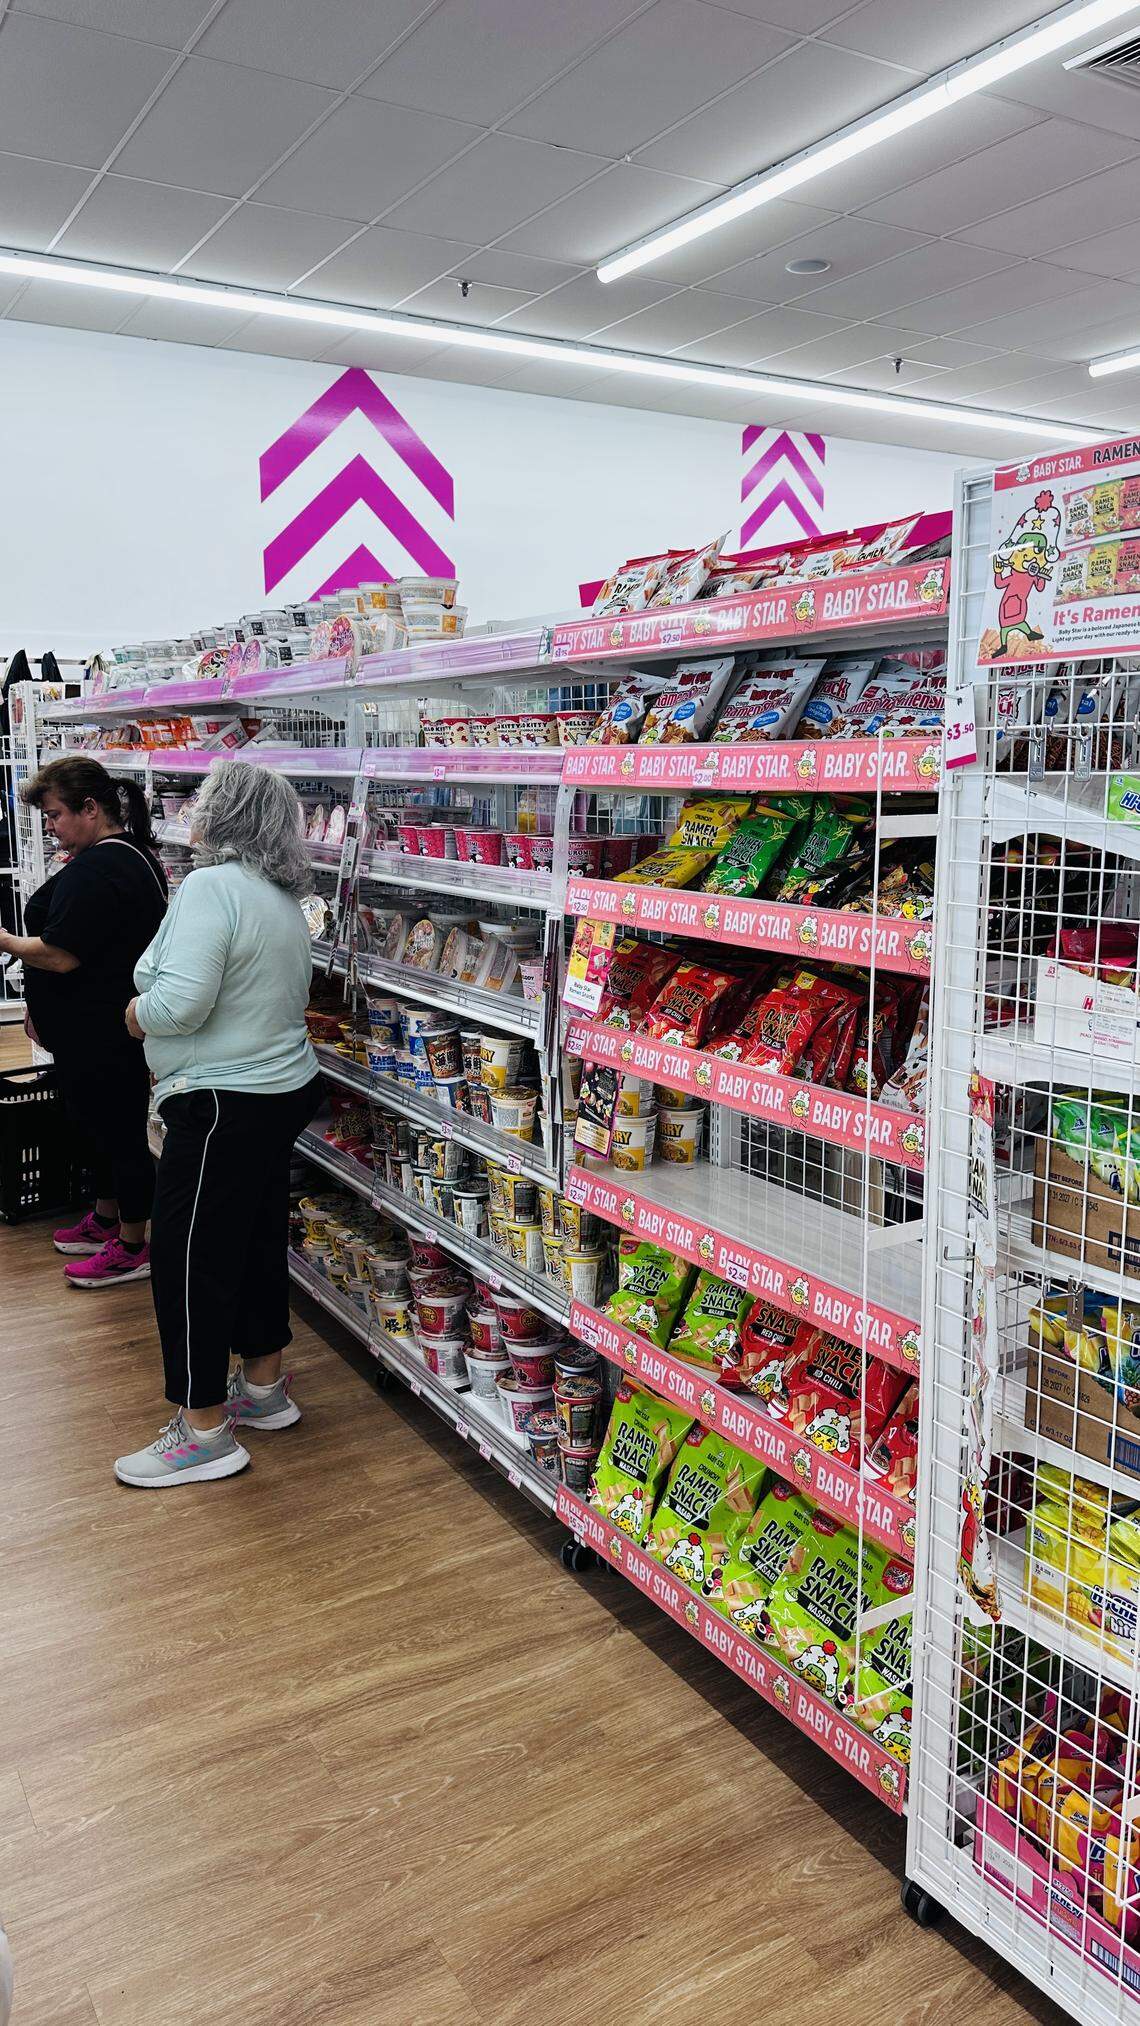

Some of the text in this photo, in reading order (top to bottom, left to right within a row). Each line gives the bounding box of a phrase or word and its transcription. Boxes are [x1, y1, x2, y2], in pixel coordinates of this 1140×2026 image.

[1033, 456, 1082, 478] BABY STAR
[752, 598, 788, 626] STAR
[823, 579, 910, 617] BABY STAR
[1053, 609, 1079, 626] It's
[580, 627, 605, 650] STAR
[946, 722, 975, 741] $3.50
[566, 755, 616, 775] BABY STAR
[639, 756, 696, 777] BABY STAR
[721, 755, 790, 778] BABY STAR
[823, 752, 866, 778] BABY
[680, 832, 715, 848] SNACK
[683, 820, 719, 838] RAMEN
[592, 891, 617, 913] STAR
[640, 898, 699, 926] BABY STAR
[724, 910, 791, 941] BABY STAR
[820, 922, 859, 949] BABY
[592, 1032, 616, 1057] STAR
[635, 1045, 690, 1079] BABY STAR
[717, 1072, 786, 1112] BABY STAR
[812, 1100, 853, 1133] BABY
[593, 1187, 617, 1214] STAR
[638, 1208, 693, 1251] BABY STAR
[728, 1268, 747, 1282] $2.50
[751, 1262, 785, 1297] STAR
[700, 1293, 741, 1312] SNACK
[705, 1283, 747, 1301] RAMEN
[756, 1307, 801, 1336] SNACK
[813, 1291, 853, 1329] BABY
[597, 1324, 621, 1355] STAR
[761, 1328, 772, 1339] RED
[640, 1350, 697, 1406] BABY STAR
[823, 1373, 843, 1390] CHILI
[617, 1421, 658, 1458] RAMEN
[721, 1405, 789, 1466] BABY STAR
[677, 1463, 725, 1504] RAMEN
[697, 1463, 721, 1482] CRUNCHY
[816, 1465, 855, 1508] BABY
[670, 1481, 713, 1520] SNACK
[582, 1513, 606, 1548] STAR
[763, 1519, 796, 1555] RAM
[626, 1550, 679, 1611] BABY STAR
[754, 1560, 778, 1583] WASABI
[809, 1556, 874, 1615] RAMEN
[799, 1575, 858, 1632] SNACK
[806, 1602, 834, 1627] WASABI
[704, 1618, 767, 1687] BABY STAR
[797, 1694, 871, 1777] BABY STAR
